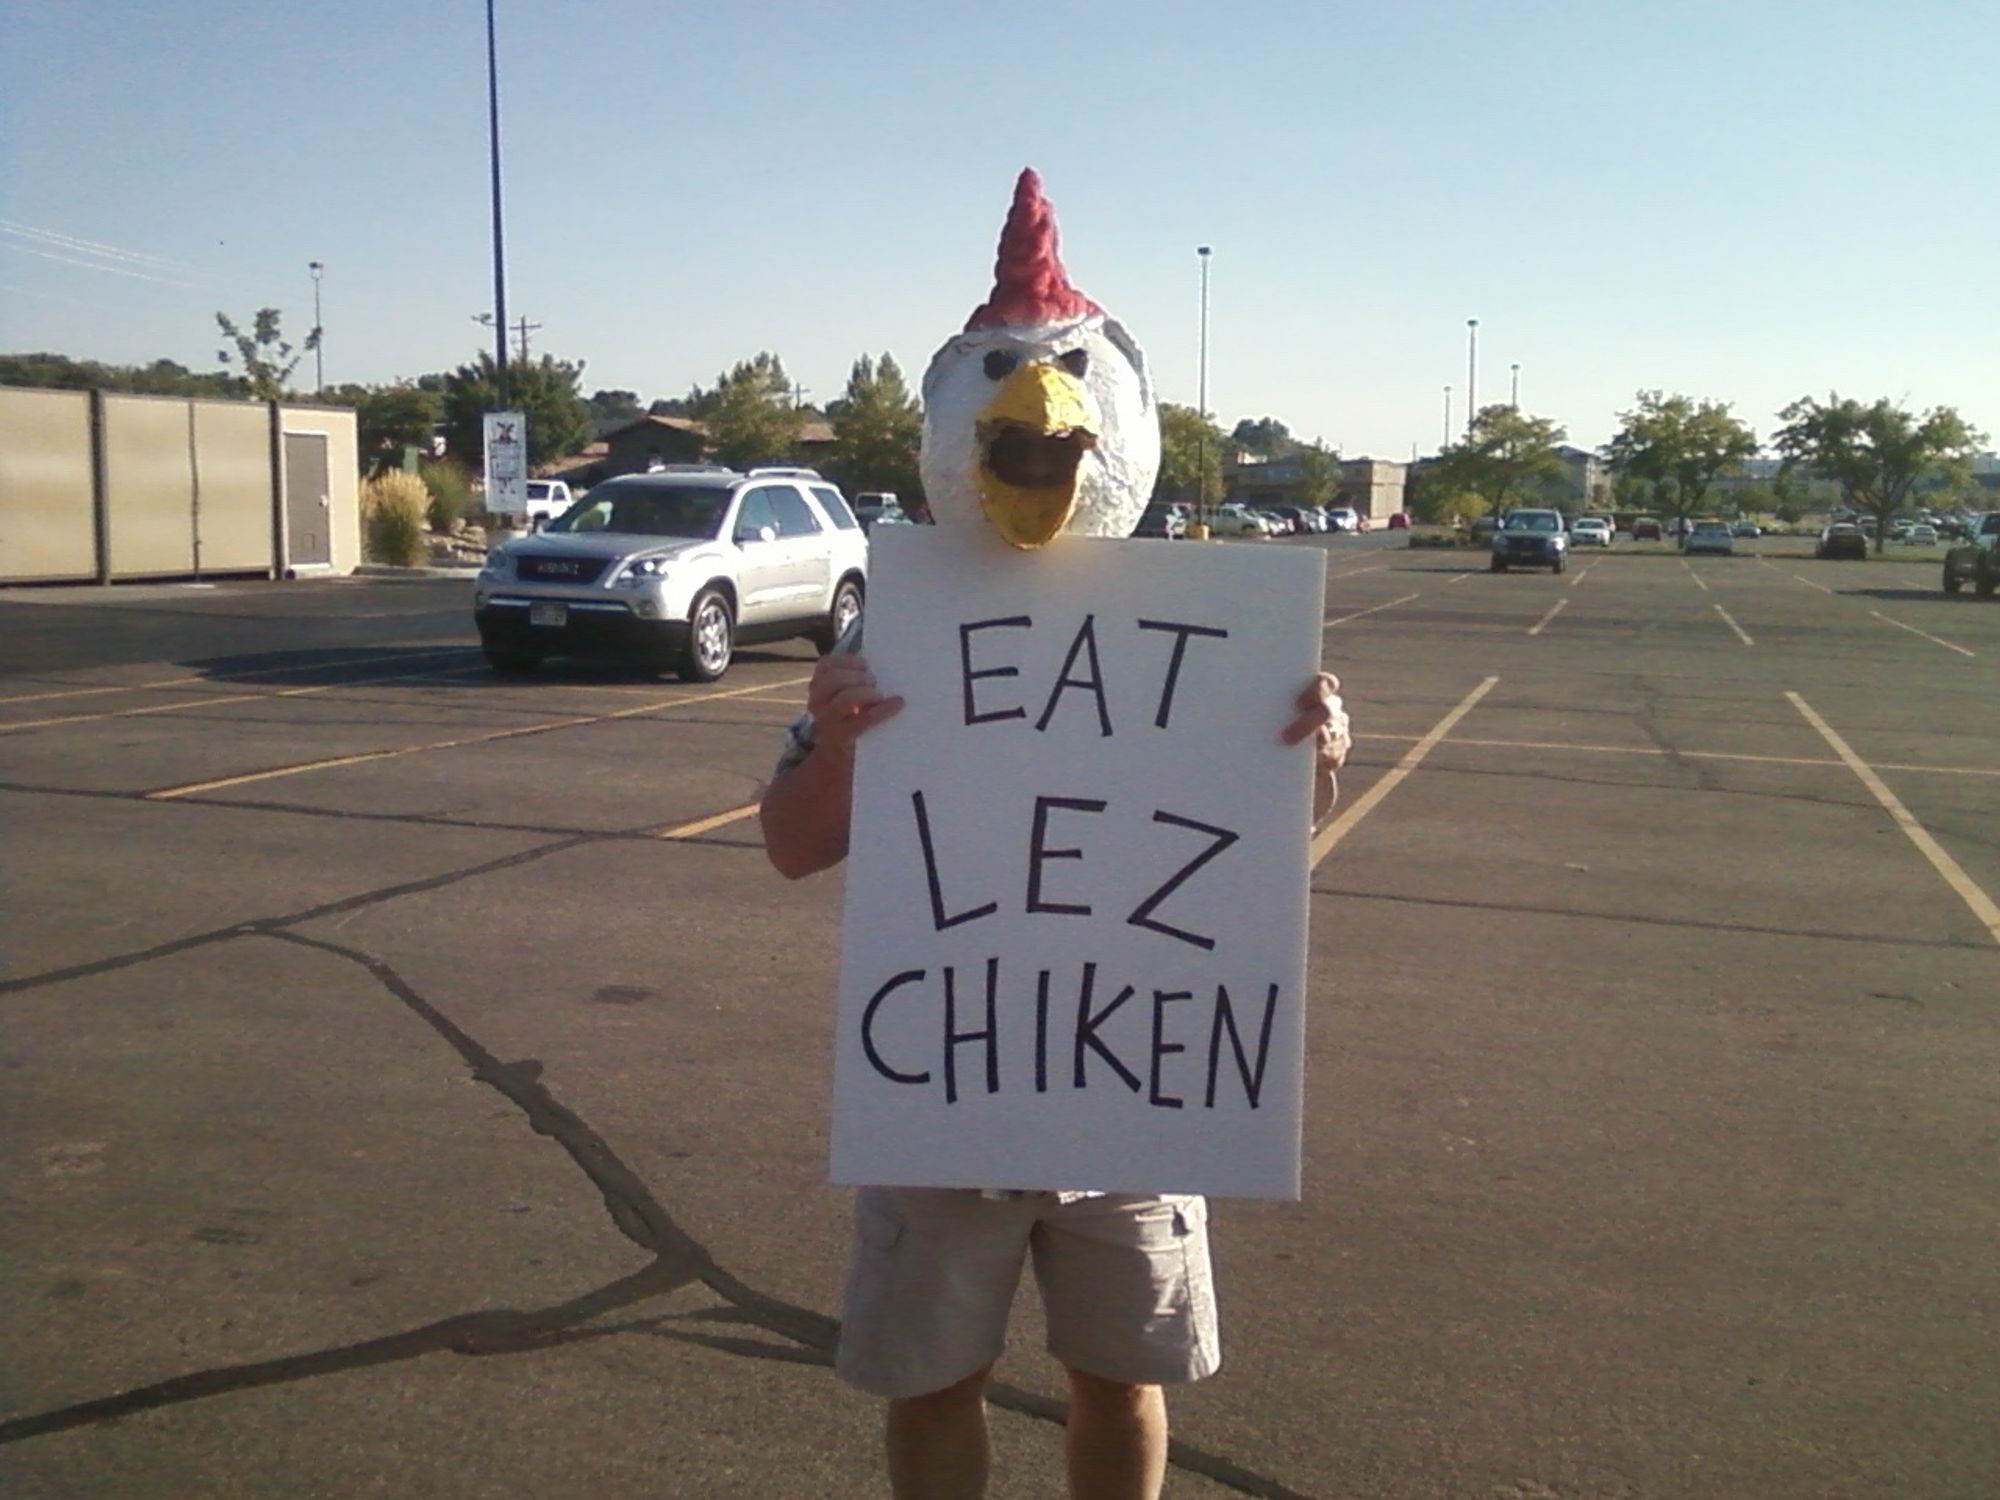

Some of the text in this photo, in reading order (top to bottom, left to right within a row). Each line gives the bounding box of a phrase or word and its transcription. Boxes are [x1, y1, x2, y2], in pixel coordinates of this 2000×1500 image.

[959, 615, 1229, 737] EAT
[911, 789, 1240, 951] LEZ
[860, 956, 1280, 1111] CHIKEN
